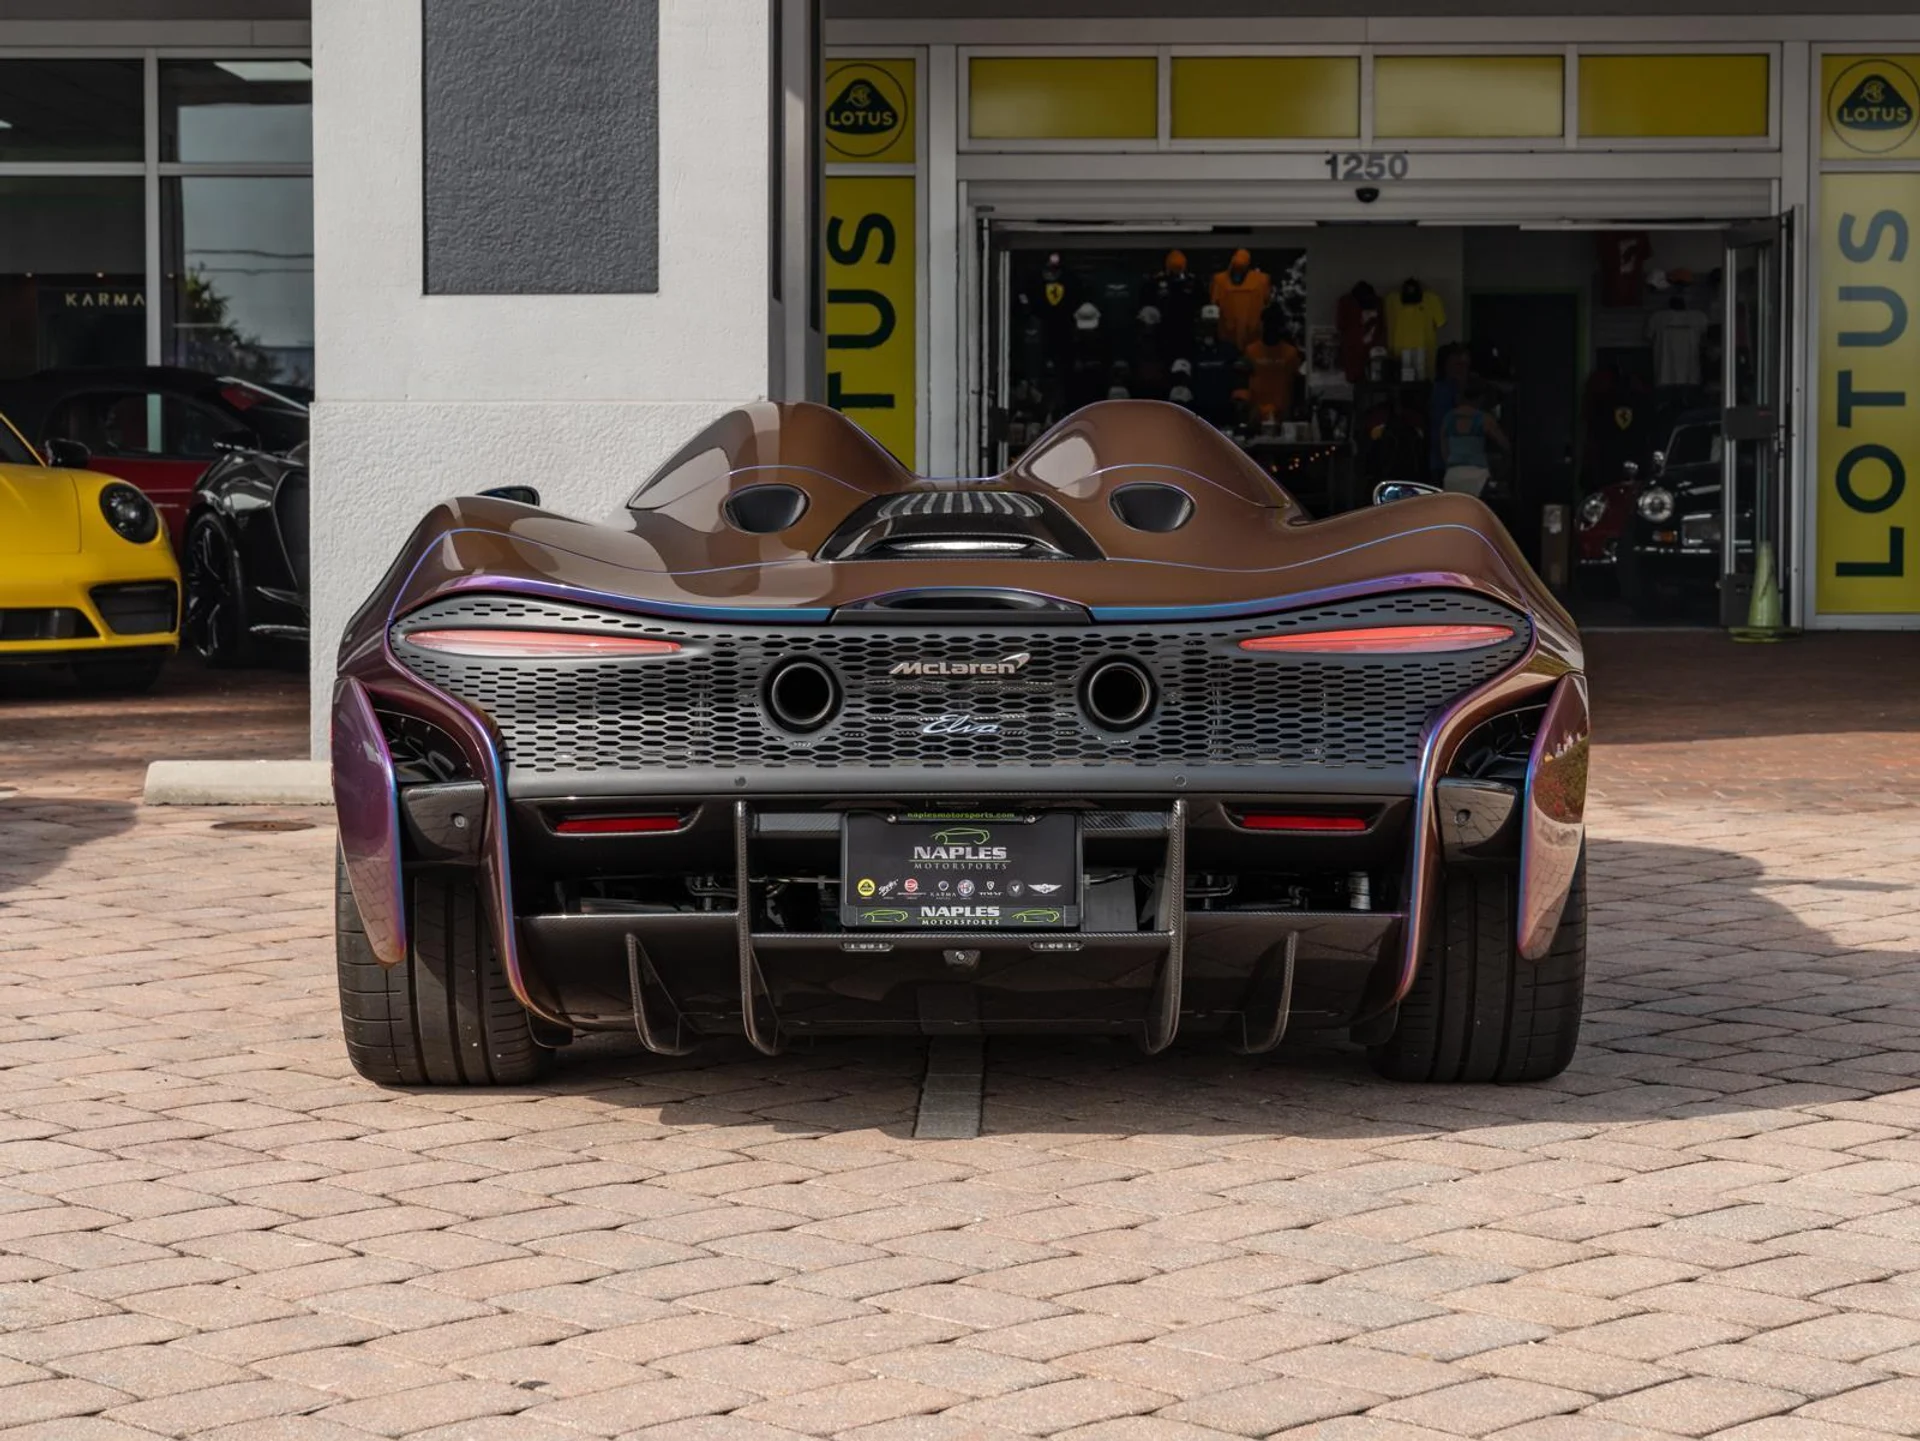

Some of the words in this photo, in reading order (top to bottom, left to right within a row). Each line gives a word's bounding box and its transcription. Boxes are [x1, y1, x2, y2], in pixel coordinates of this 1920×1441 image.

[829, 111, 893, 126] LOTUS
[1843, 107, 1907, 122] LOTUS
[1325, 152, 1409, 180] 1250
[65, 293, 145, 306] KARMA
[827, 213, 896, 410] TUS
[1835, 209, 1909, 577] LOTUS
[889, 660, 1017, 675] McLaren
[907, 812, 1015, 820] naplesmotorsports.com
[913, 846, 1007, 860] NAPLES
[914, 862, 1008, 870] MOTORSPORTS
[920, 905, 1000, 917] NAPLES
